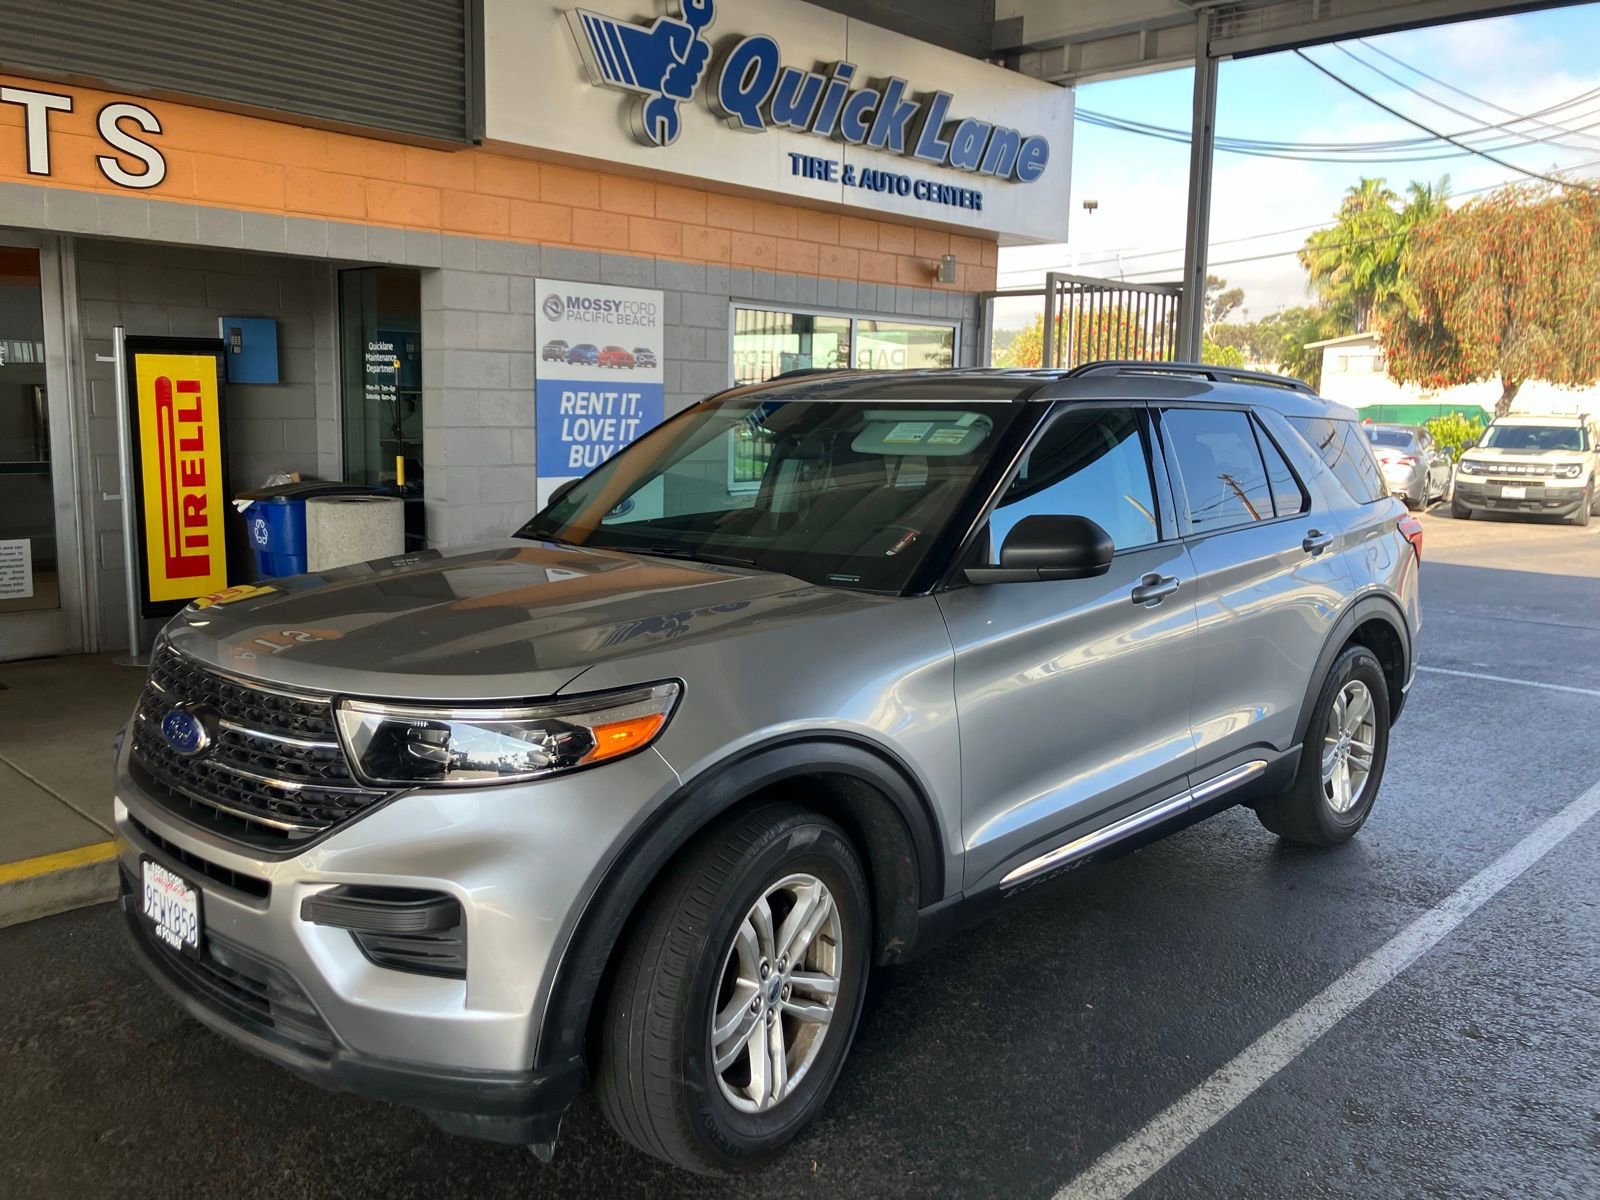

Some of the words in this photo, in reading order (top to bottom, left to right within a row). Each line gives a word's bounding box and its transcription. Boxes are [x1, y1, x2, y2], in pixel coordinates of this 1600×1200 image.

[716, 34, 921, 154] Quick
[912, 90, 1051, 183] Lane
[788, 152, 839, 183] TIRE
[842, 163, 857, 187] &
[858, 167, 912, 197] AUTO
[913, 179, 983, 211] CENTER
[566, 309, 615, 324] PACIFIC
[616, 313, 656, 328] BEACH
[368, 341, 394, 351] Quicklane
[366, 363, 395, 374] Departmen
[560, 391, 619, 415] RENT
[620, 393, 643, 418] IT,
[561, 418, 617, 441] LOVE
[619, 419, 640, 441] IT
[568, 444, 615, 468] BUY
[154, 376, 211, 579] PIRELLI
